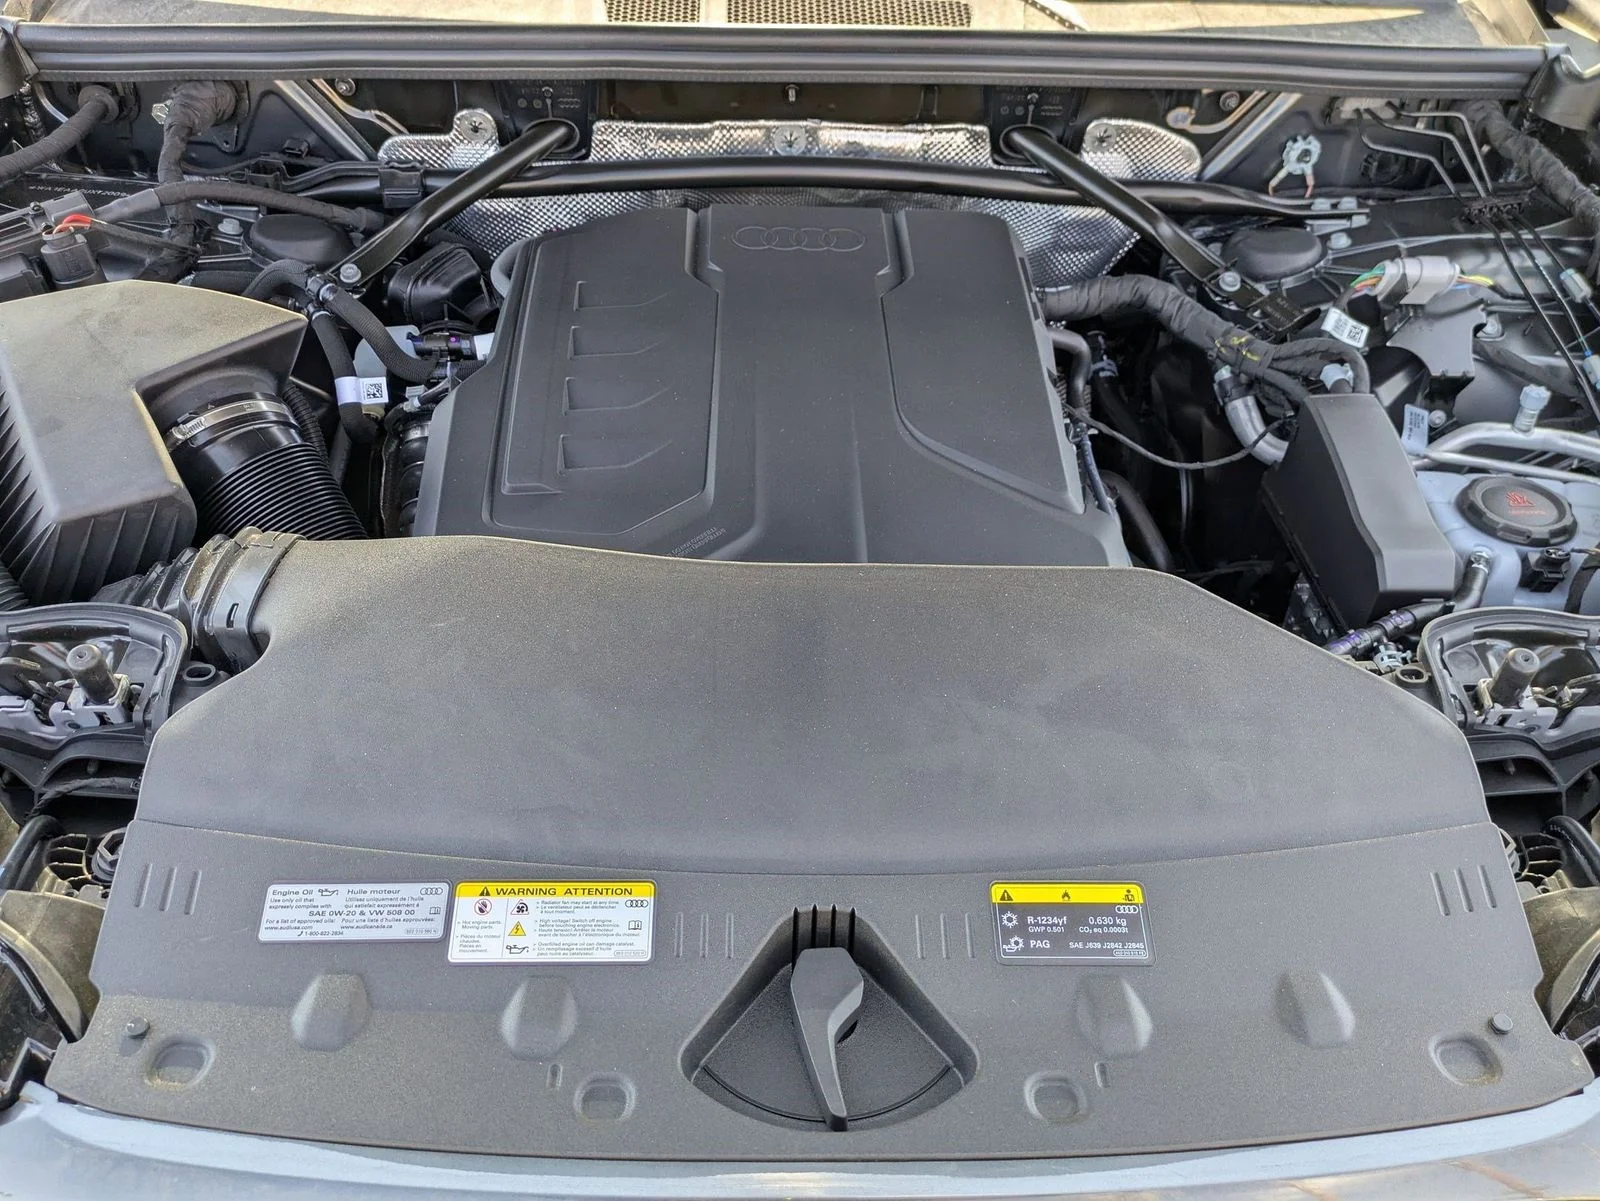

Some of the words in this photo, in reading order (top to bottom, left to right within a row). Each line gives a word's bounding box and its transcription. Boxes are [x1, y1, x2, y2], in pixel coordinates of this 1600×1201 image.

[1027, 916, 1067, 926] R-1234yf
[1088, 917, 1113, 925] 0.630
[1115, 916, 1127, 926] kg
[1030, 940, 1051, 948] PAG
